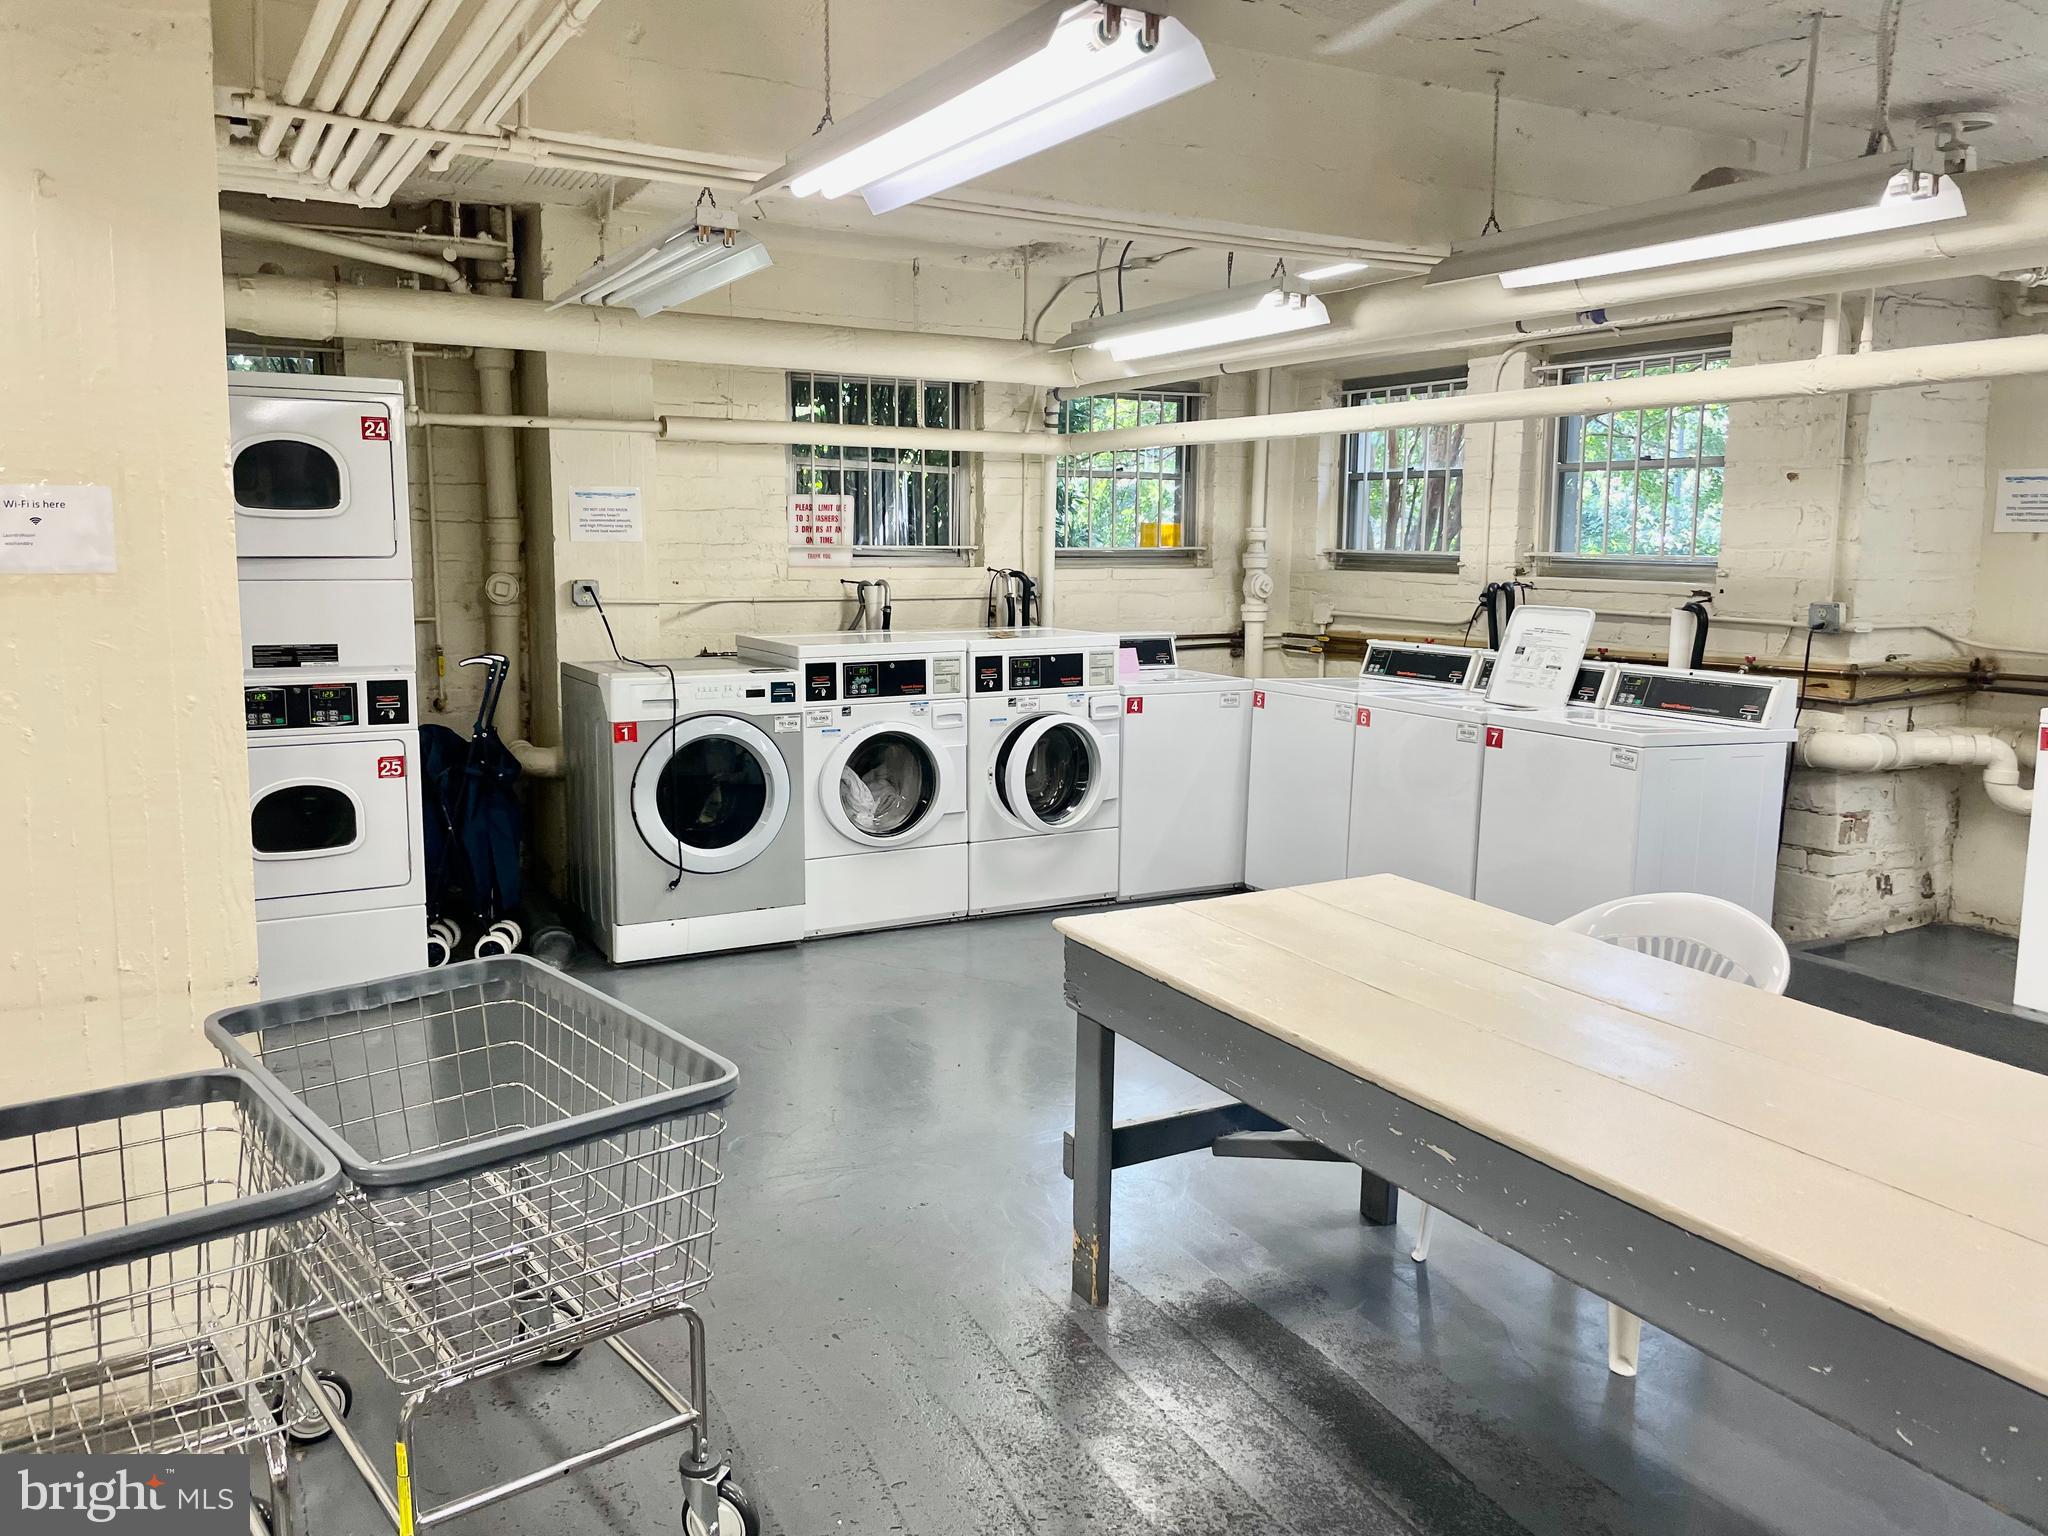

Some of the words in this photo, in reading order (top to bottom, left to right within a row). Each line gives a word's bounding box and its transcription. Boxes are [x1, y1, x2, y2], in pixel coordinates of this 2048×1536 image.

[364, 421, 386, 437] 24
[3, 500, 30, 508] Wi-Fi
[32, 500, 40, 508] is
[42, 500, 66, 508] here
[795, 503, 814, 511] PLEAS
[818, 504, 833, 512] LIMIT
[835, 504, 847, 512] UE
[801, 525, 823, 533] DRYRS
[1131, 700, 1139, 712] 4
[1256, 695, 1262, 705] 5
[1360, 712, 1367, 725] 6
[621, 727, 629, 741] 1
[1491, 732, 1499, 745] 7
[379, 761, 402, 776] 25
